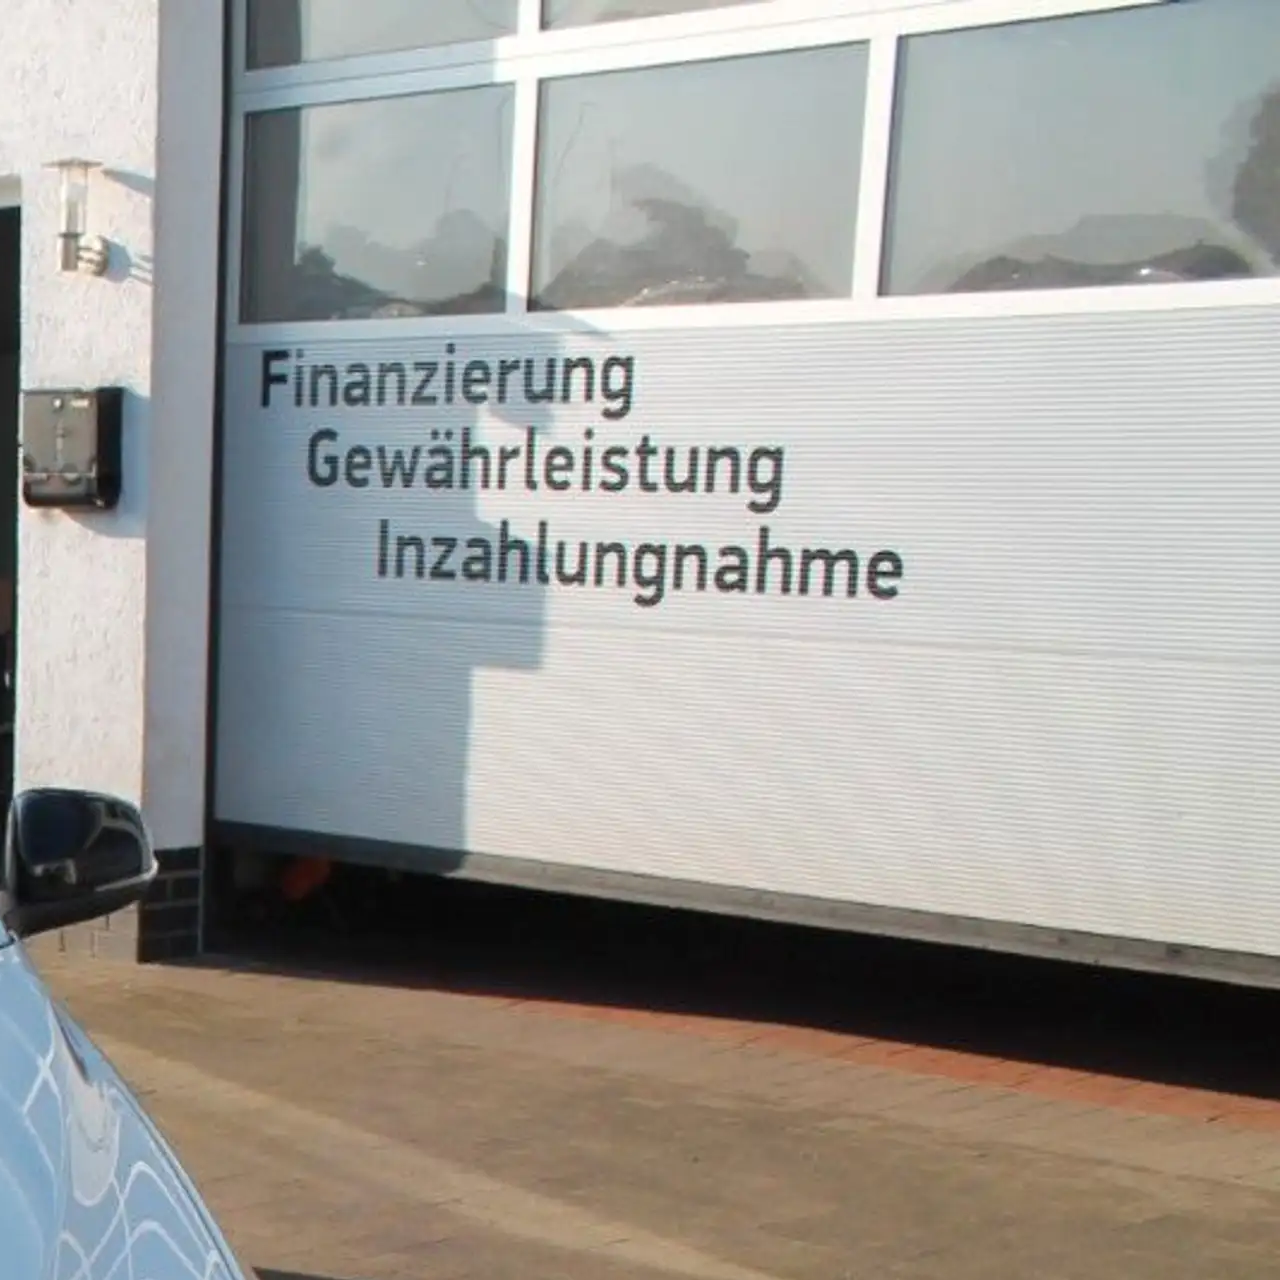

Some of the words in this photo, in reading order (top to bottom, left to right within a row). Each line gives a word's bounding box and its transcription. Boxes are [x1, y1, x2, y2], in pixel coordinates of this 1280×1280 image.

[260, 343, 634, 419] Finanzierung
[307, 427, 785, 513] Gewährleistung
[376, 519, 904, 606] Inzahlungnahme
